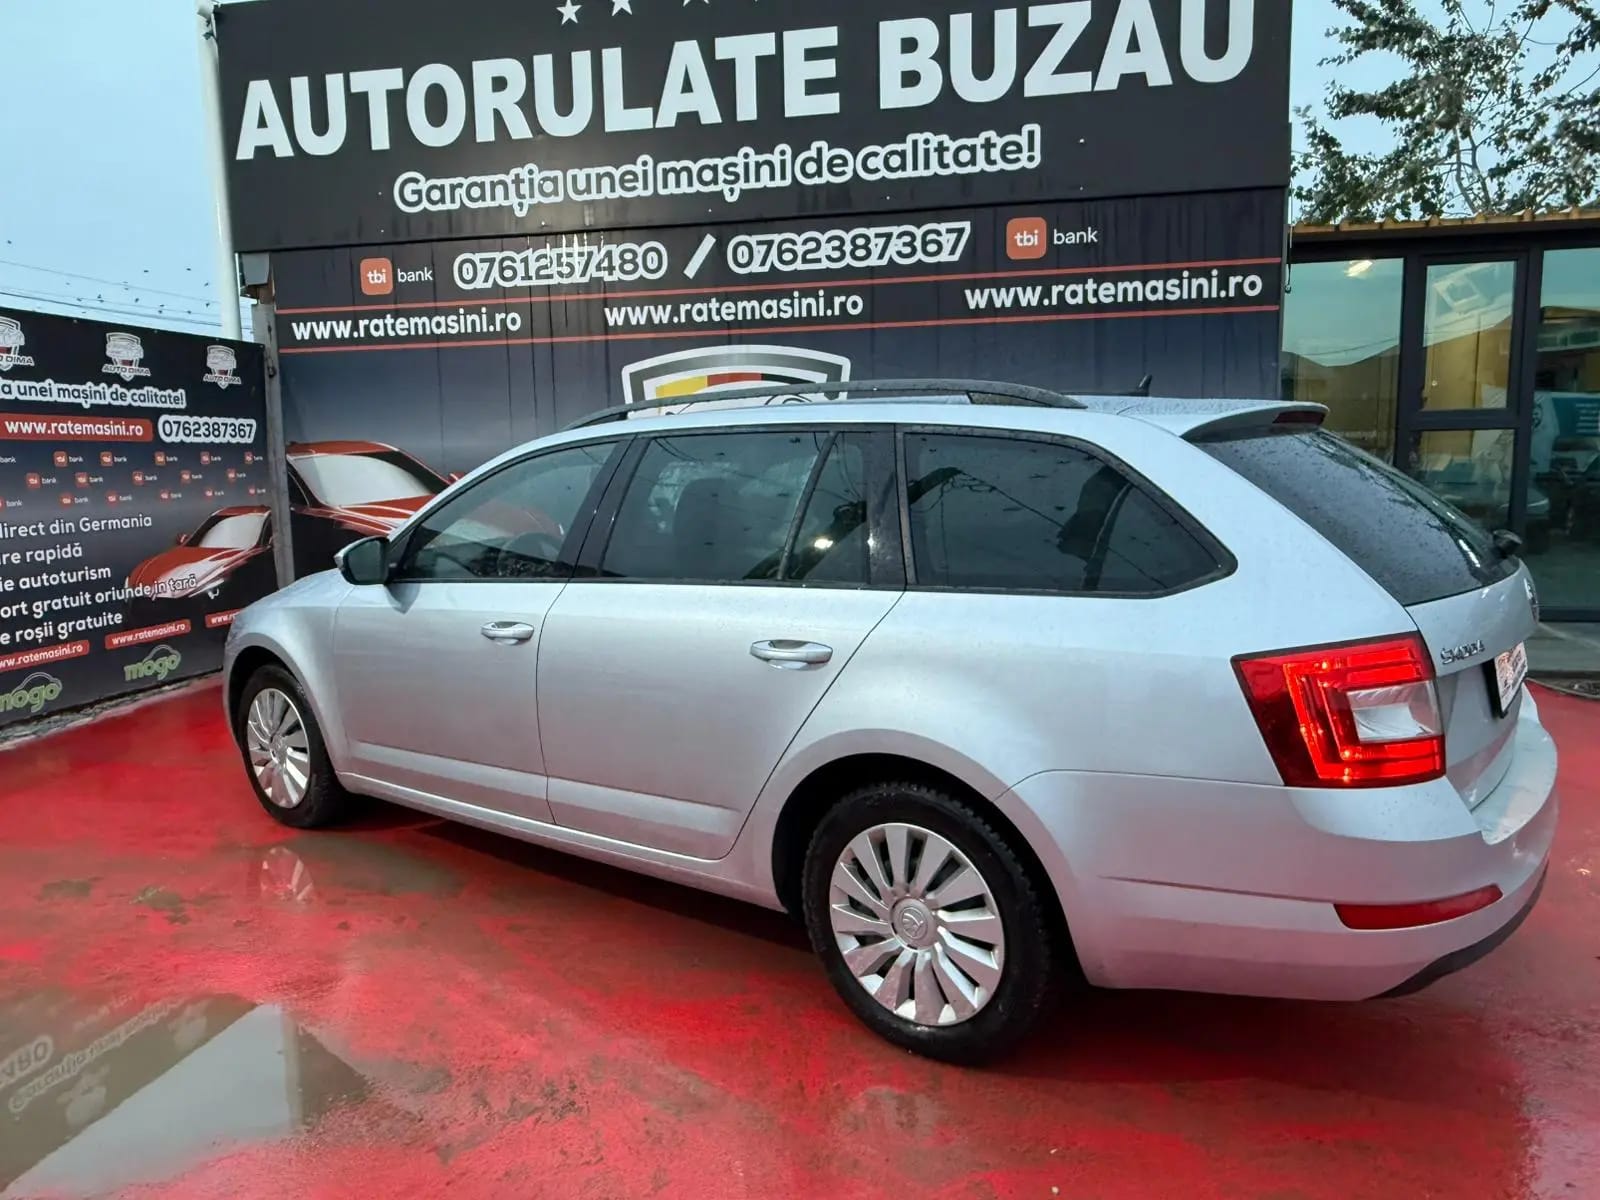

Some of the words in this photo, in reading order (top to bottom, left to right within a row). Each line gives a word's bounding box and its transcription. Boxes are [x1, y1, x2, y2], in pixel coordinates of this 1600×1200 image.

[235, 25, 841, 161] AUTORULATE
[879, 0, 1255, 110] BUZAU
[394, 164, 562, 217] Garanția
[567, 155, 653, 201] unei
[657, 144, 791, 202] mașini
[795, 140, 853, 184] de
[856, 124, 1041, 179] calitate!
[1014, 230, 1039, 247] tbi
[1053, 227, 1099, 245] bank
[453, 242, 668, 290] 0761257480
[727, 221, 971, 274] 0762387367
[366, 268, 387, 285] tbi
[397, 267, 433, 283] bank
[965, 269, 1263, 309] www.ratemasini.ro
[604, 289, 864, 327] www.ratemasini.ro
[292, 307, 521, 341] www.ratemasini.ro
[17, 380, 54, 399] unei
[56, 382, 108, 407] mașini
[109, 385, 128, 403] de
[130, 388, 185, 407] calitate!
[5, 420, 143, 437] www.ratemasini.ro
[160, 416, 255, 441] 0762387367
[49, 519, 76, 535] din
[79, 514, 152, 532] Germania
[25, 542, 82, 565] rapidă
[19, 566, 111, 589] autoturism
[32, 592, 92, 618] gratuit
[95, 582, 151, 603] oriunde
[15, 621, 54, 645] roșii
[57, 612, 123, 640] gratuite
[112, 623, 186, 645] www.ratemasini.ro
[124, 655, 181, 683] mogo
